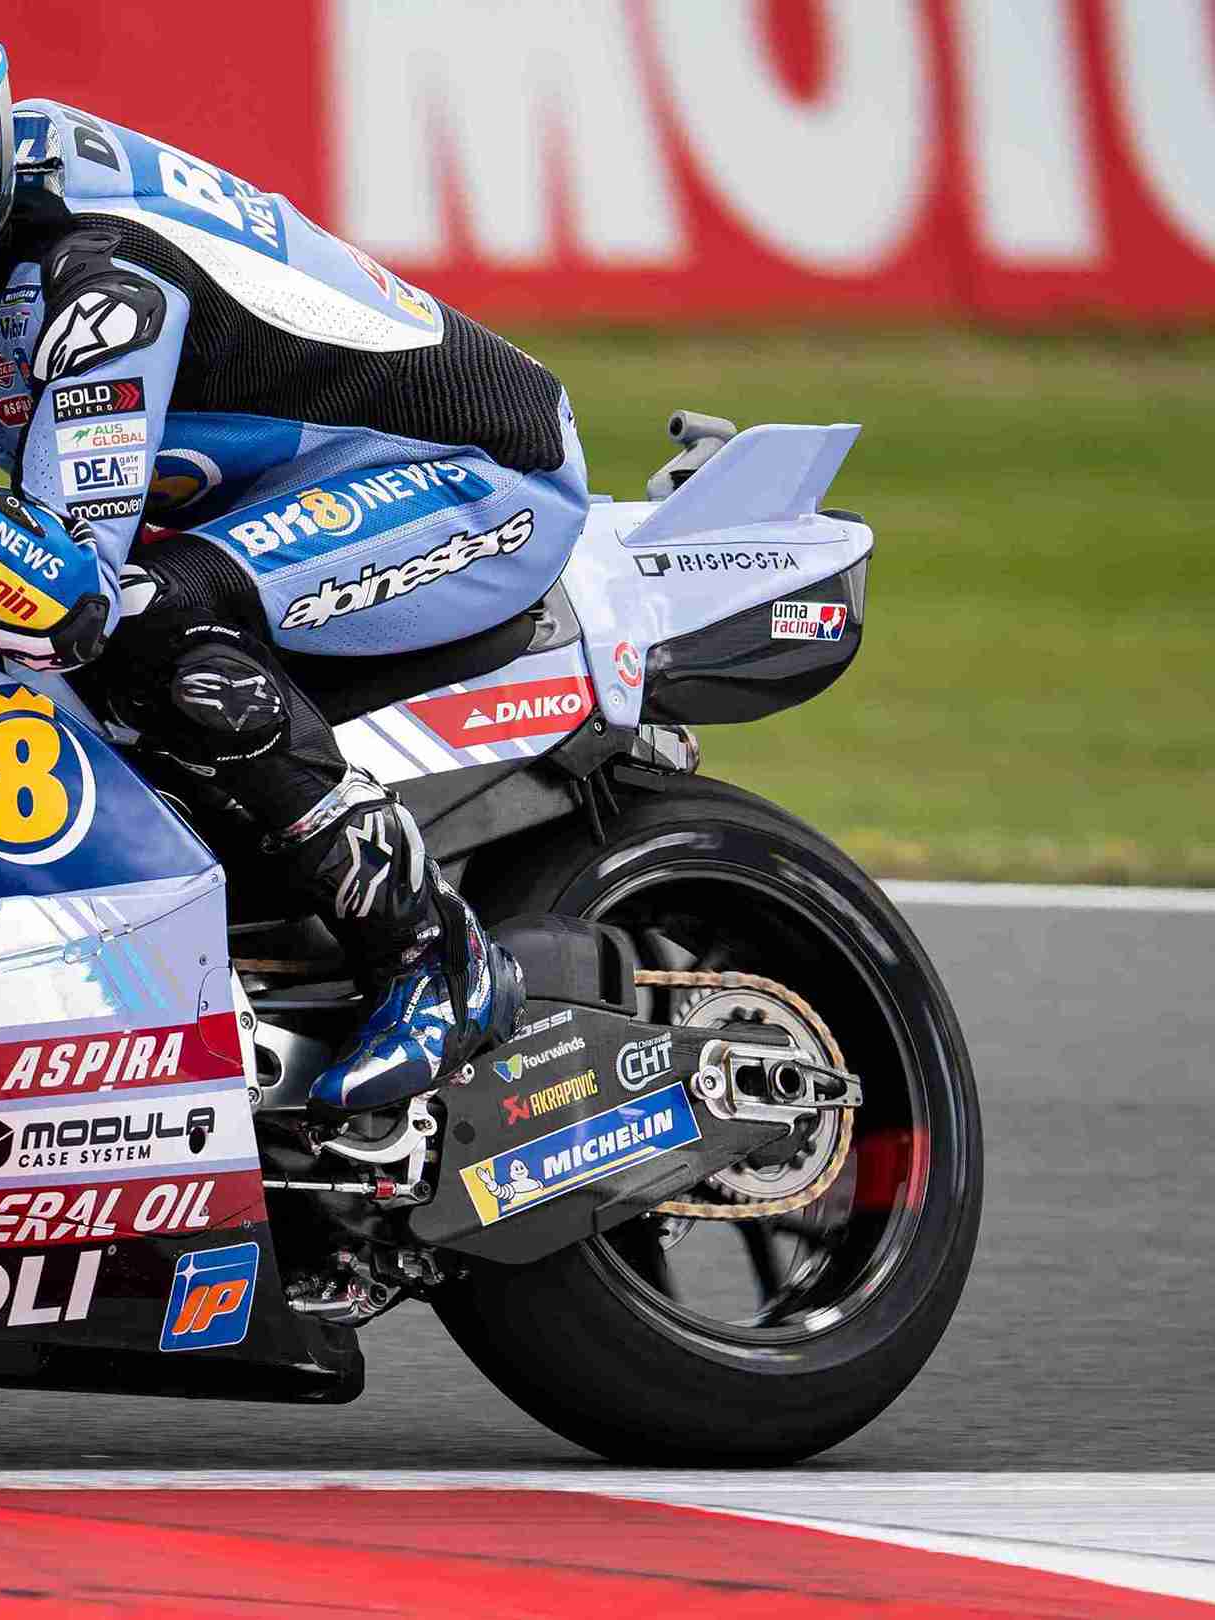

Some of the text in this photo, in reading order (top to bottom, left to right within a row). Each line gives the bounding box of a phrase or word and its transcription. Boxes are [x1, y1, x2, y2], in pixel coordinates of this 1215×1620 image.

[56, 385, 111, 409] BOLD
[57, 404, 113, 418] RIDERS
[93, 434, 145, 447] GLOBAL
[94, 423, 124, 435] AUS
[229, 461, 468, 557] BK8 NEWS
[281, 508, 535, 629] alpinestars
[677, 552, 801, 573] RISPOSTA
[774, 603, 808, 618] uma
[774, 620, 817, 638] racing
[494, 693, 582, 723] DAIKO
[2, 1030, 185, 1092] ASPIRA
[523, 1035, 586, 1069] fourwinds
[625, 1041, 673, 1080] CHT
[20, 1107, 215, 1149] MODULA
[18, 1144, 152, 1168] CASE SYSTEM
[543, 1109, 673, 1180] MICHELIN
[132, 1180, 216, 1232] OIL
